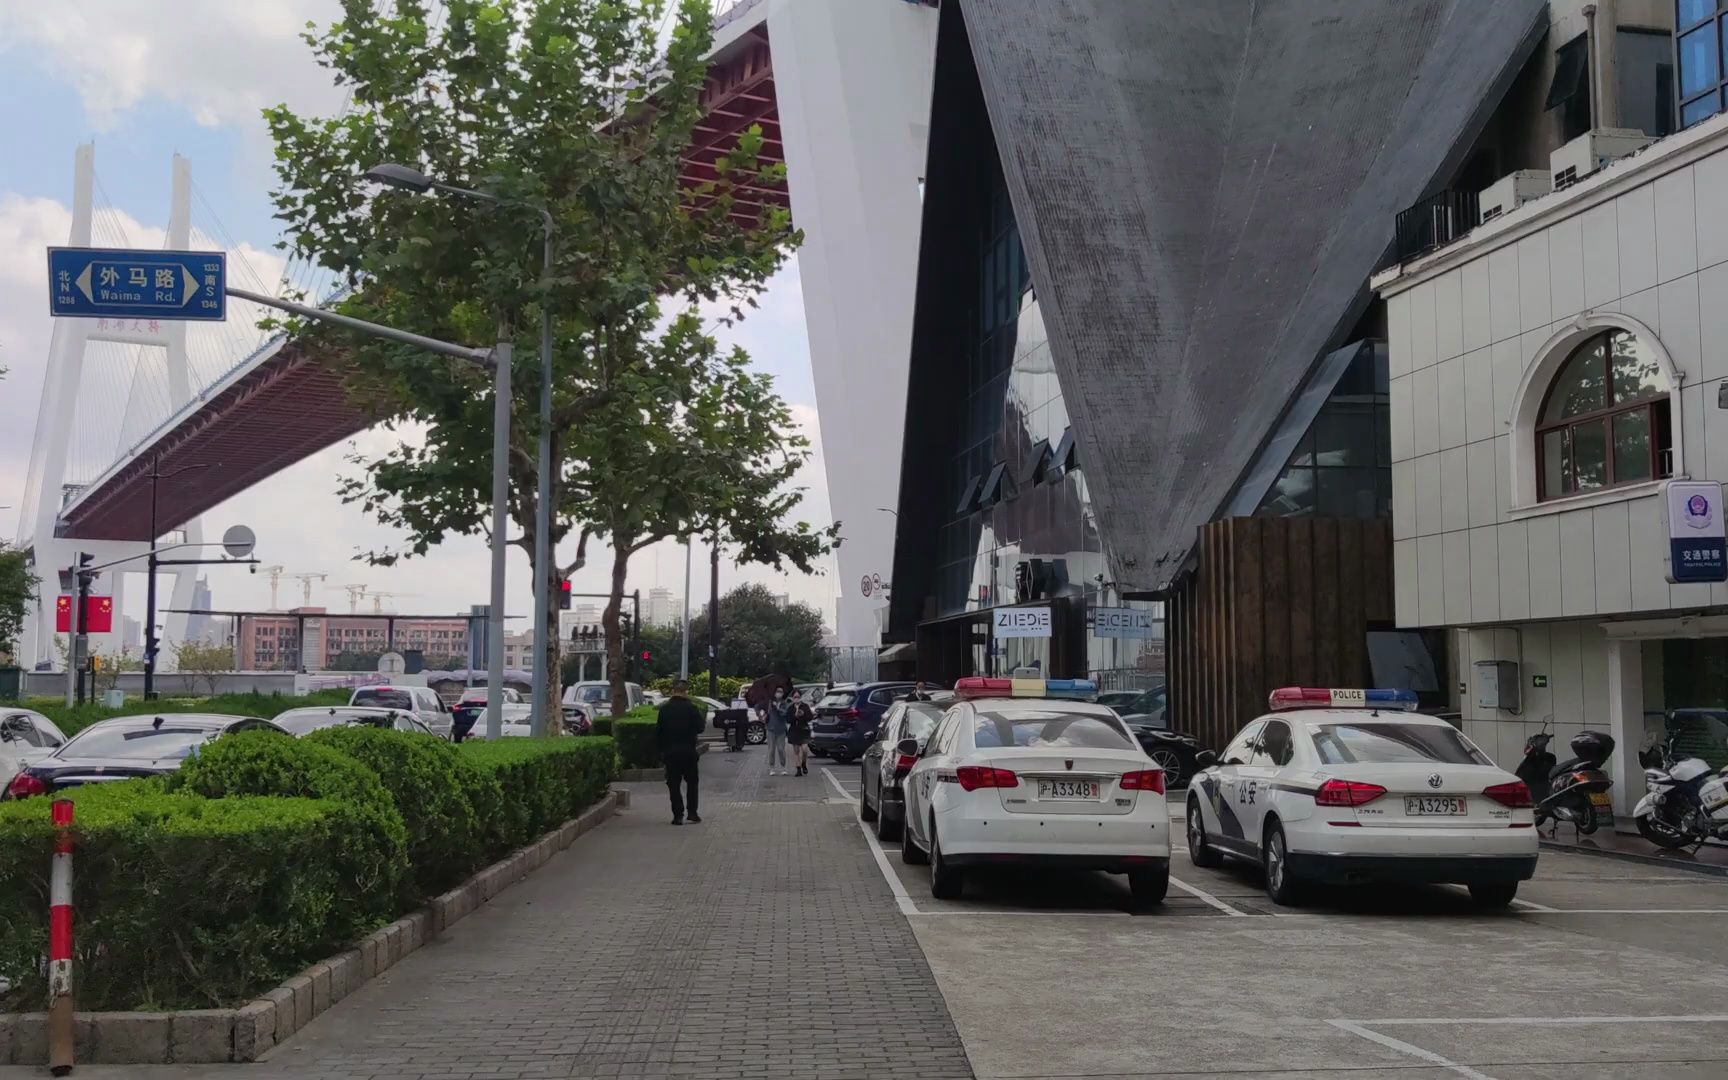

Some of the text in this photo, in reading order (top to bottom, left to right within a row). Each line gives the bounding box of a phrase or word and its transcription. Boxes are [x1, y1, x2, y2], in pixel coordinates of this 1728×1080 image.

[58, 271, 71, 281] 北
[100, 266, 175, 288] 外马路
[204, 274, 217, 286] 南
[61, 283, 70, 292] N
[206, 287, 215, 296] S
[101, 290, 176, 302] Waima Rd.
[1333, 690, 1362, 699] POLICE
[1239, 779, 1257, 805] 公安
